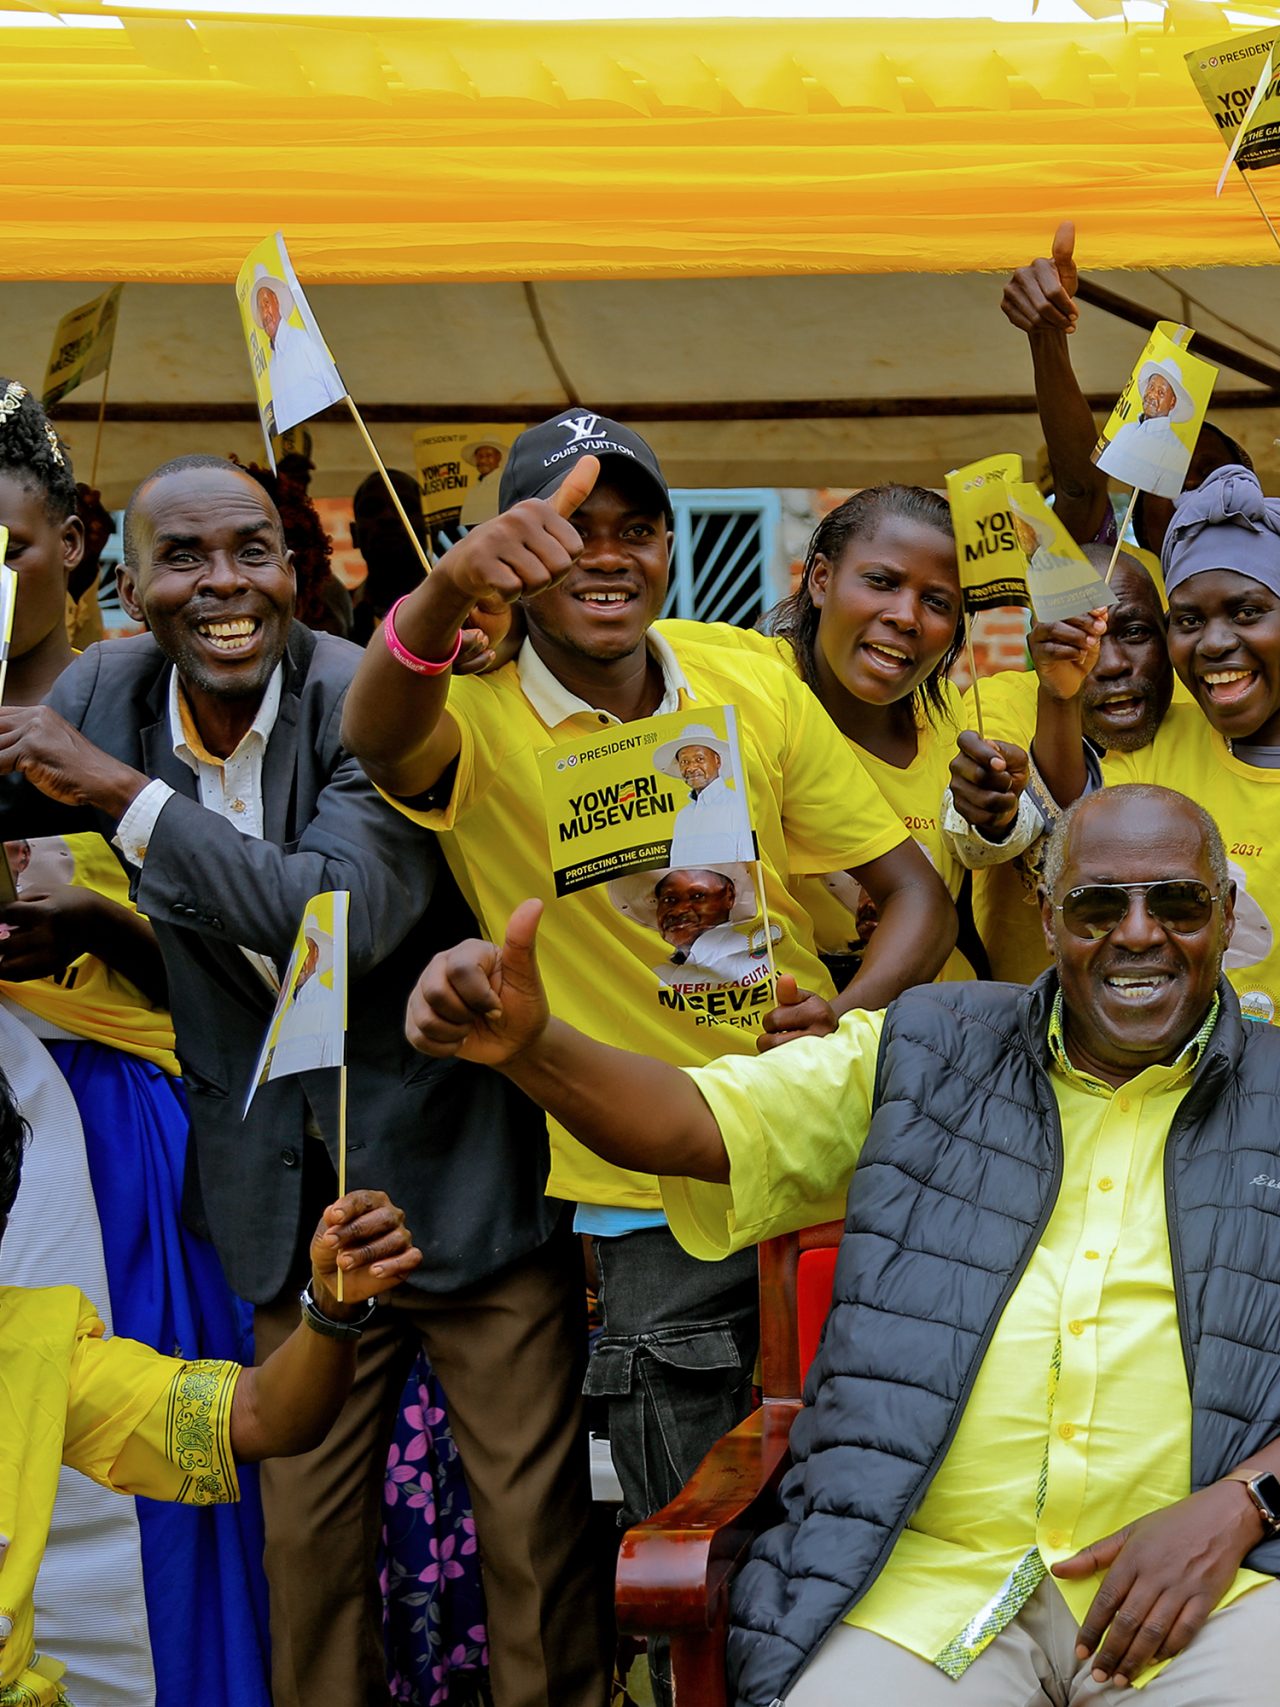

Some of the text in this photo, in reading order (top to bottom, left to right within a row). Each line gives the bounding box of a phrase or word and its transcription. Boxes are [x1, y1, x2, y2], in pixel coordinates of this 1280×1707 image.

[1248, 129, 1264, 142] THE
[543, 440, 636, 468] LOUIS VUITTON
[579, 735, 642, 764] PRESIDENT
[568, 774, 658, 818] YOWERI
[558, 793, 675, 843] MUSEVENI
[904, 816, 937, 831] 2031
[565, 855, 618, 880] PROTECTING
[618, 850, 637, 862] THE
[638, 844, 667, 858] GAINS
[1230, 841, 1263, 858] 2031
[669, 963, 770, 994] WERI KAGUTA
